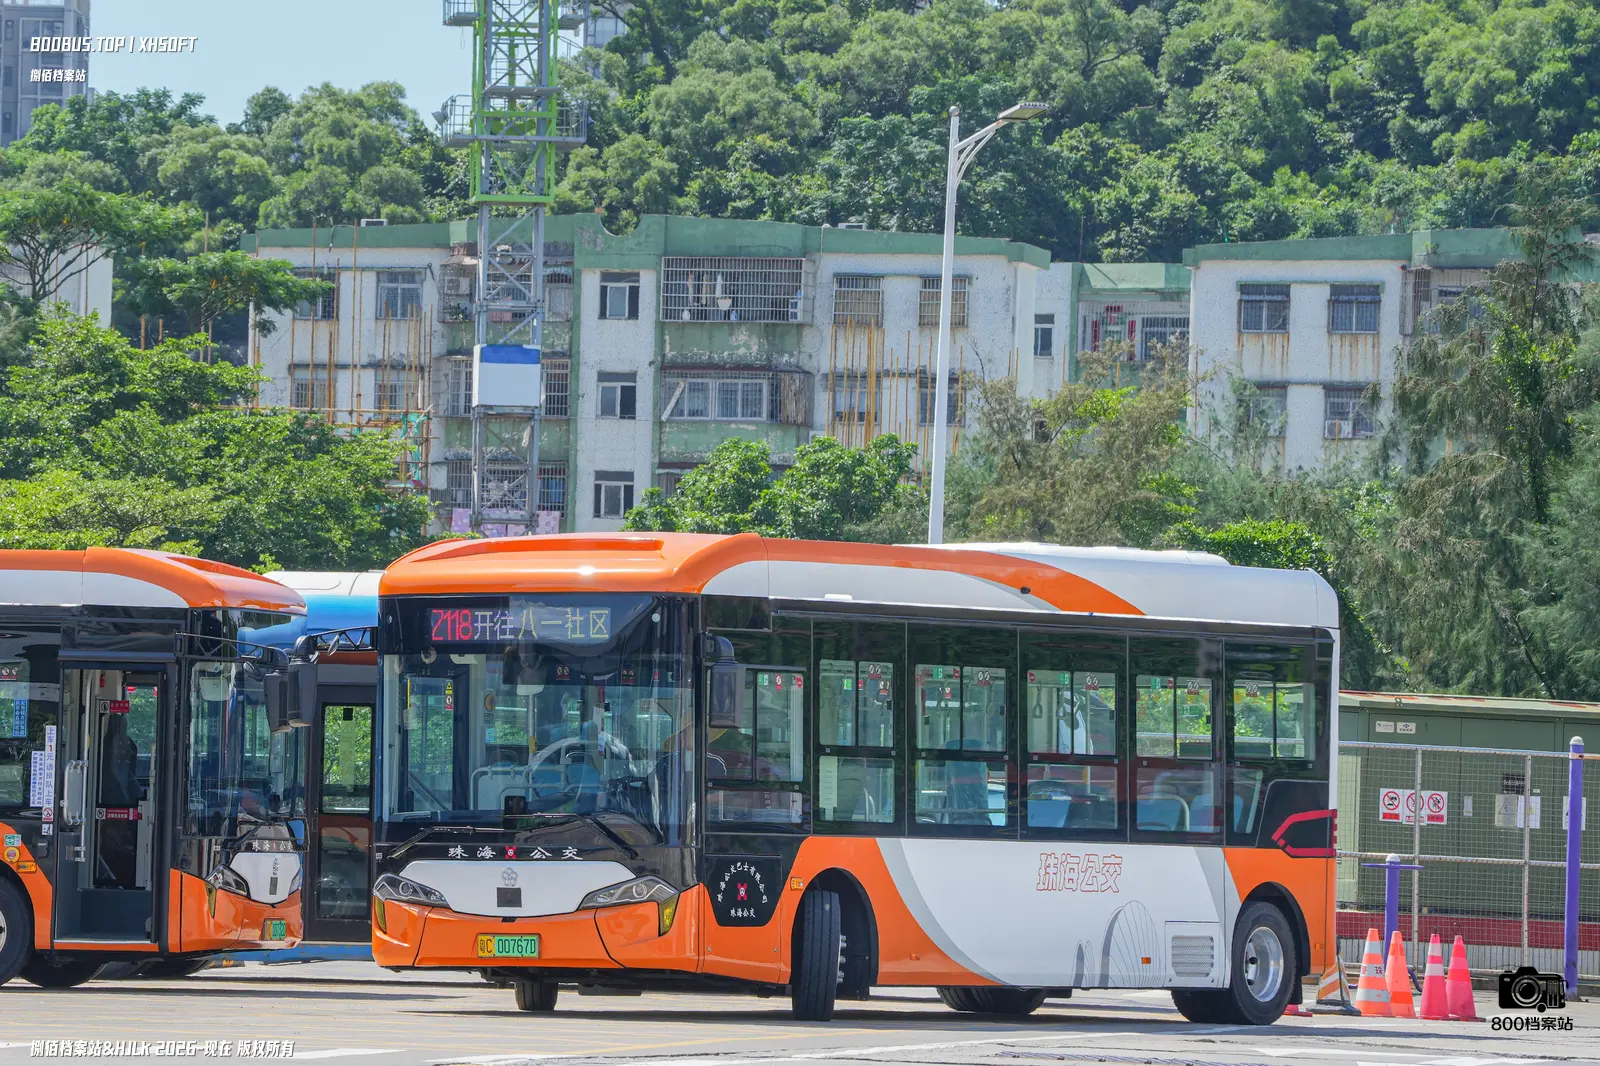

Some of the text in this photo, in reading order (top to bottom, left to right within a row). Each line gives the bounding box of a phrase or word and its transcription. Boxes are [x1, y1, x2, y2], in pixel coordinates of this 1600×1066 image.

[1036, 853, 1123, 893] 珠海公交
[730, 907, 756, 918] 珠海公交
